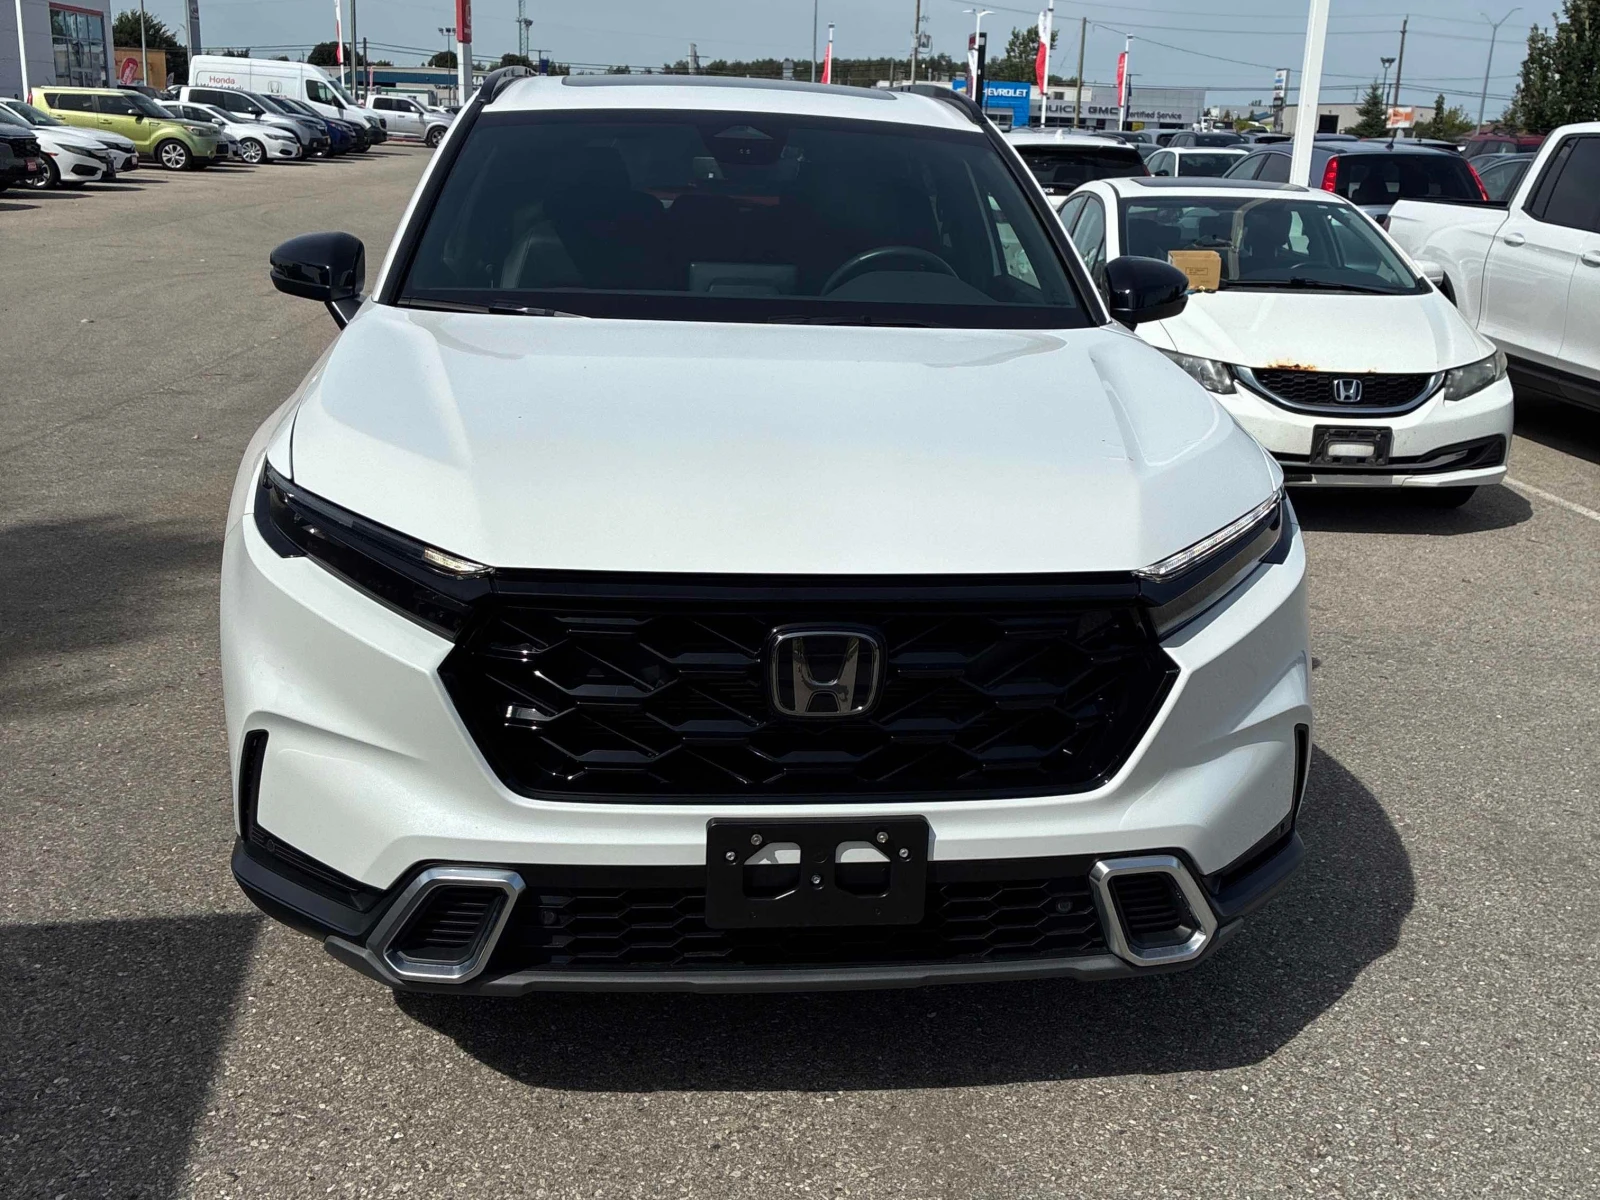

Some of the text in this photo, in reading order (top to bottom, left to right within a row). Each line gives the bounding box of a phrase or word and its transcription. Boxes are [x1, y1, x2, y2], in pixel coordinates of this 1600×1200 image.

[209, 76, 235, 85] Honda
[982, 88, 1028, 97] HEVROLET
[1088, 106, 1119, 115] GMC
[1128, 111, 1182, 120] ertified Service
